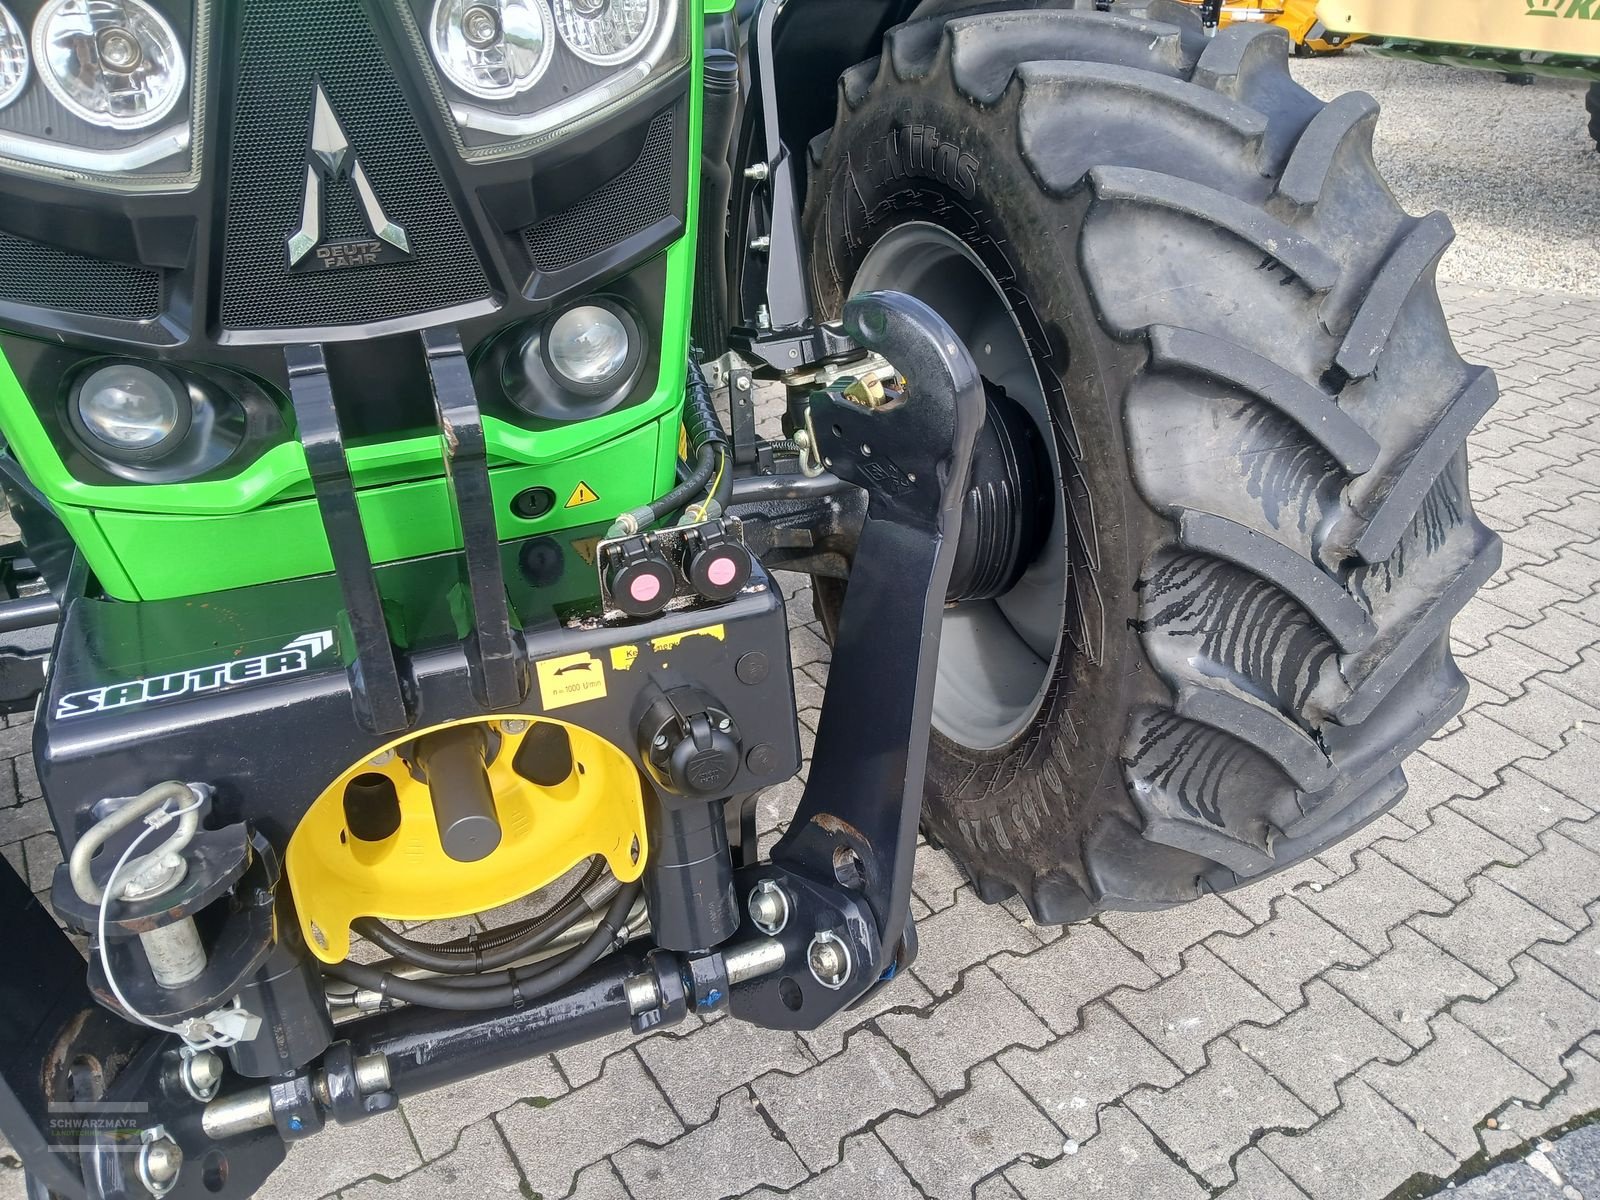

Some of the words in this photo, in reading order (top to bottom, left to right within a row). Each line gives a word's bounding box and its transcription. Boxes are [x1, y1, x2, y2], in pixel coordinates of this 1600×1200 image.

[316, 242, 382, 258] DEUTZ
[324, 253, 377, 268] FAHR
[55, 649, 307, 720] SAUTER
[565, 683, 581, 693] 1000
